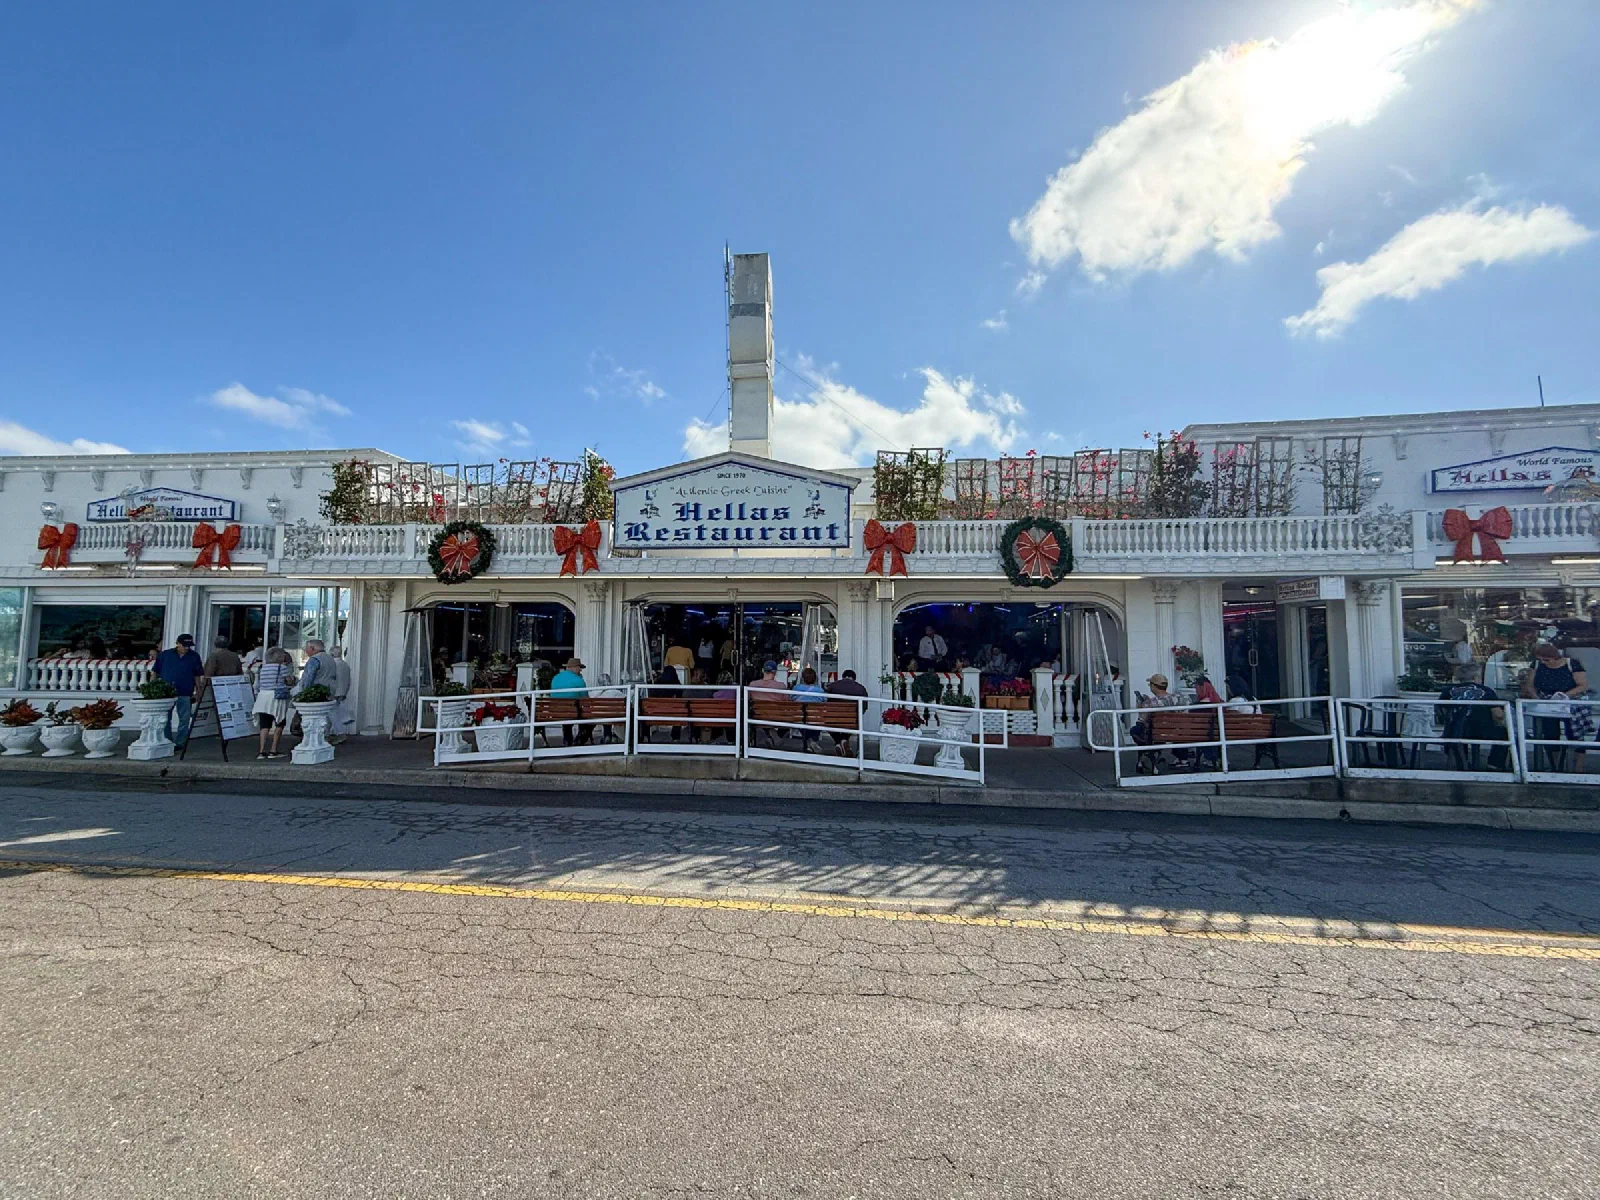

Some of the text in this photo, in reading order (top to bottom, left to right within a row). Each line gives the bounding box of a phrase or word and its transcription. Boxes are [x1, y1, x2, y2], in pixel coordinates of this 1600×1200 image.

[1517, 457, 1593, 467] World Famous
[1449, 467, 1552, 486] Hellas
[720, 485, 751, 497] Greek
[97, 504, 137, 517] Hell
[671, 501, 791, 521] Hellas
[623, 521, 840, 542] Restaurant
